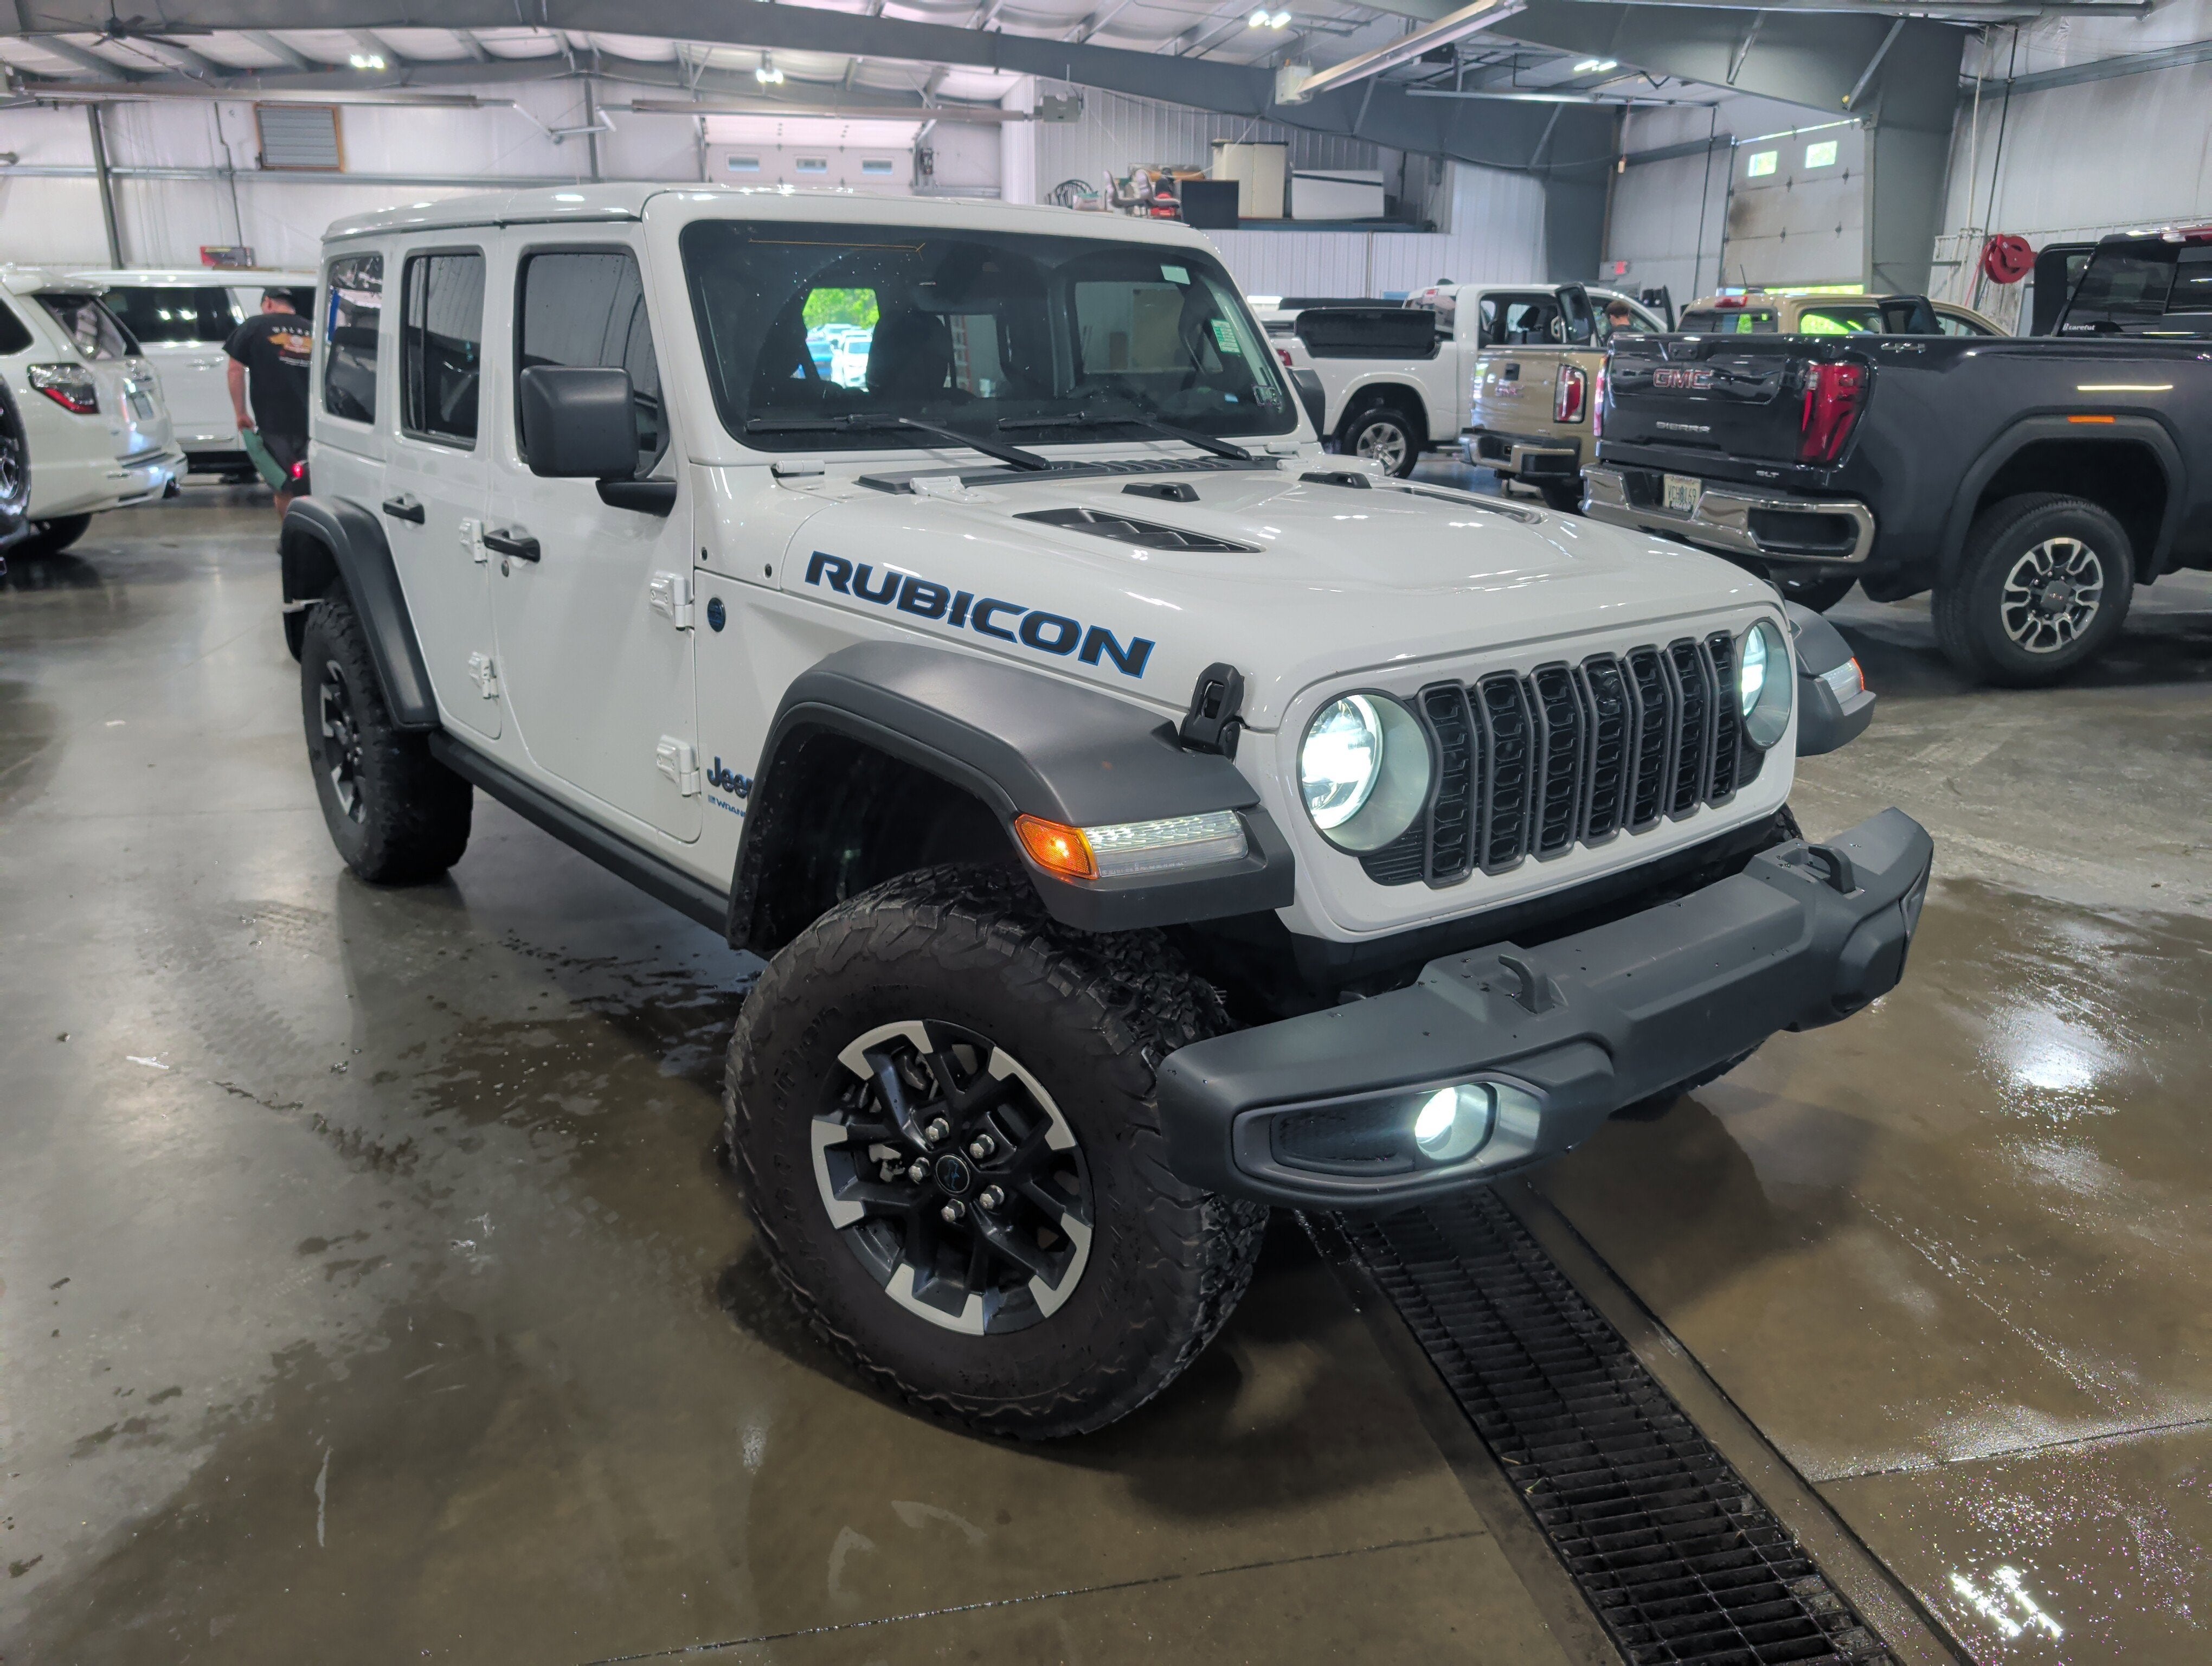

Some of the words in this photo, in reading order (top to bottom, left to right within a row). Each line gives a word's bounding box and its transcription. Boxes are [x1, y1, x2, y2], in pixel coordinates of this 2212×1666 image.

[1653, 368, 1714, 389] GMC
[1656, 421, 1711, 432] SIERRA
[805, 550, 1155, 679] RUBICON
[716, 797, 747, 817] WRAN
